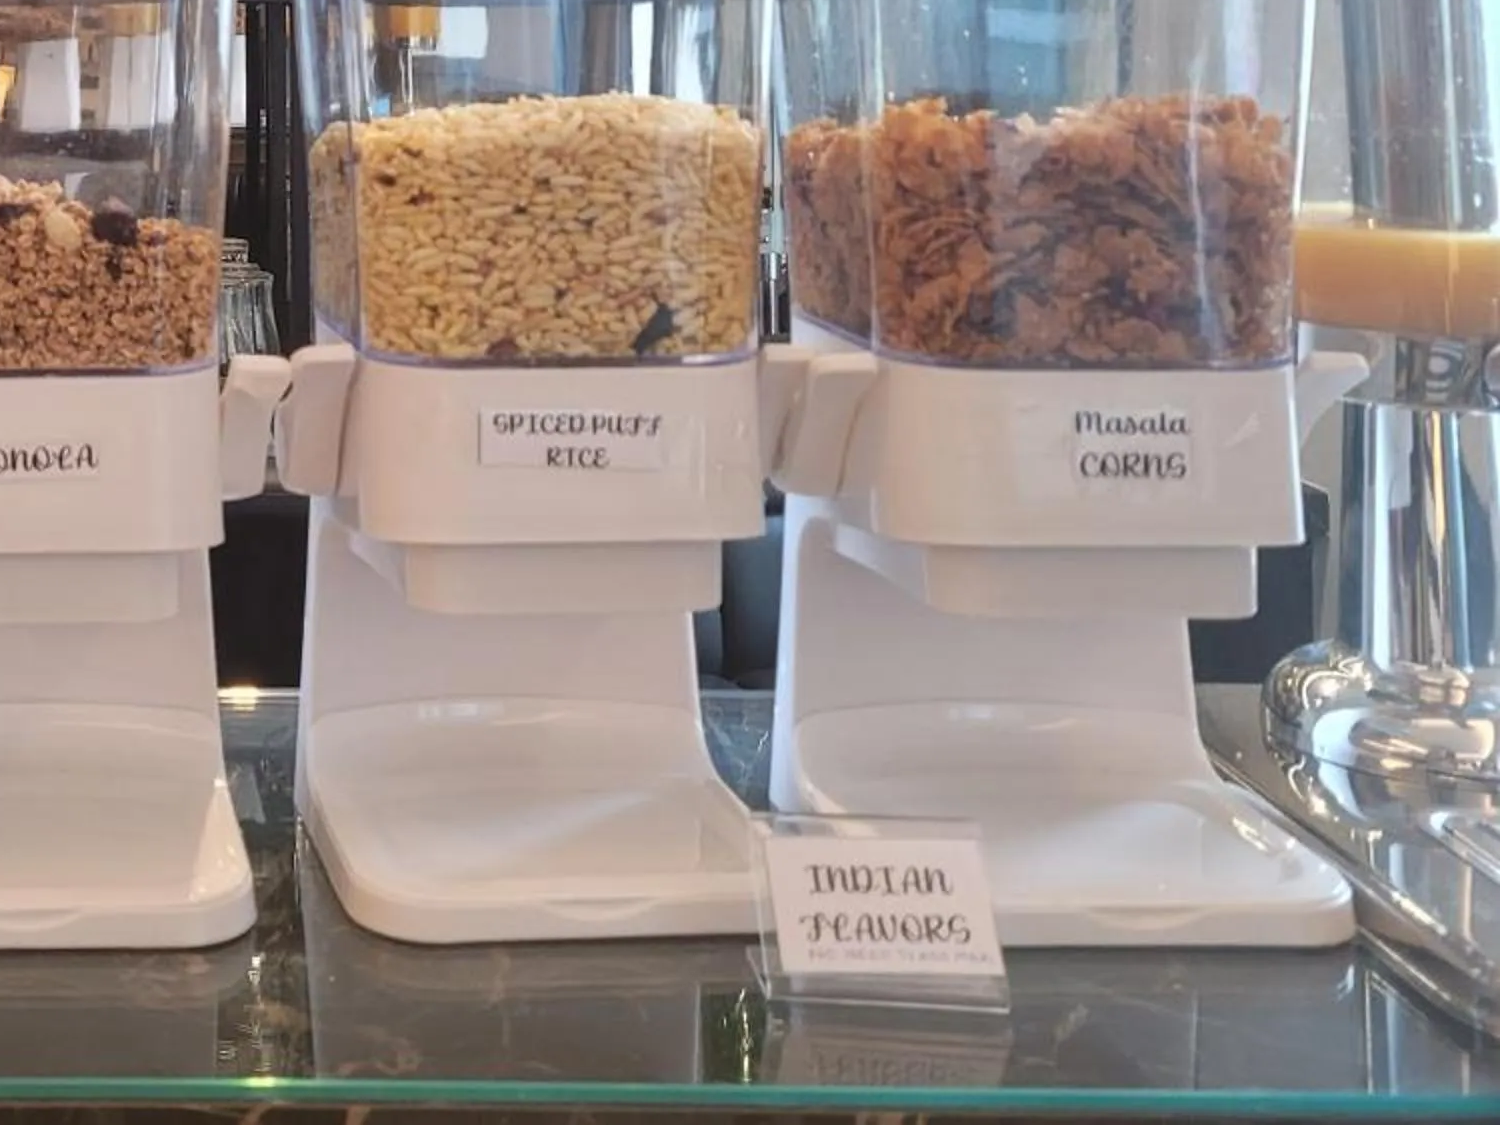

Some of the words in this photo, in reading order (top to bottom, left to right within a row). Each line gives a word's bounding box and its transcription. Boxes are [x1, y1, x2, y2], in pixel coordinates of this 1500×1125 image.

[1075, 410, 1190, 436] Masala
[546, 446, 610, 469] RICE
[1080, 451, 1187, 479] CORNS
[803, 864, 954, 896] INDIAN
[799, 912, 971, 944] FLAVORS
